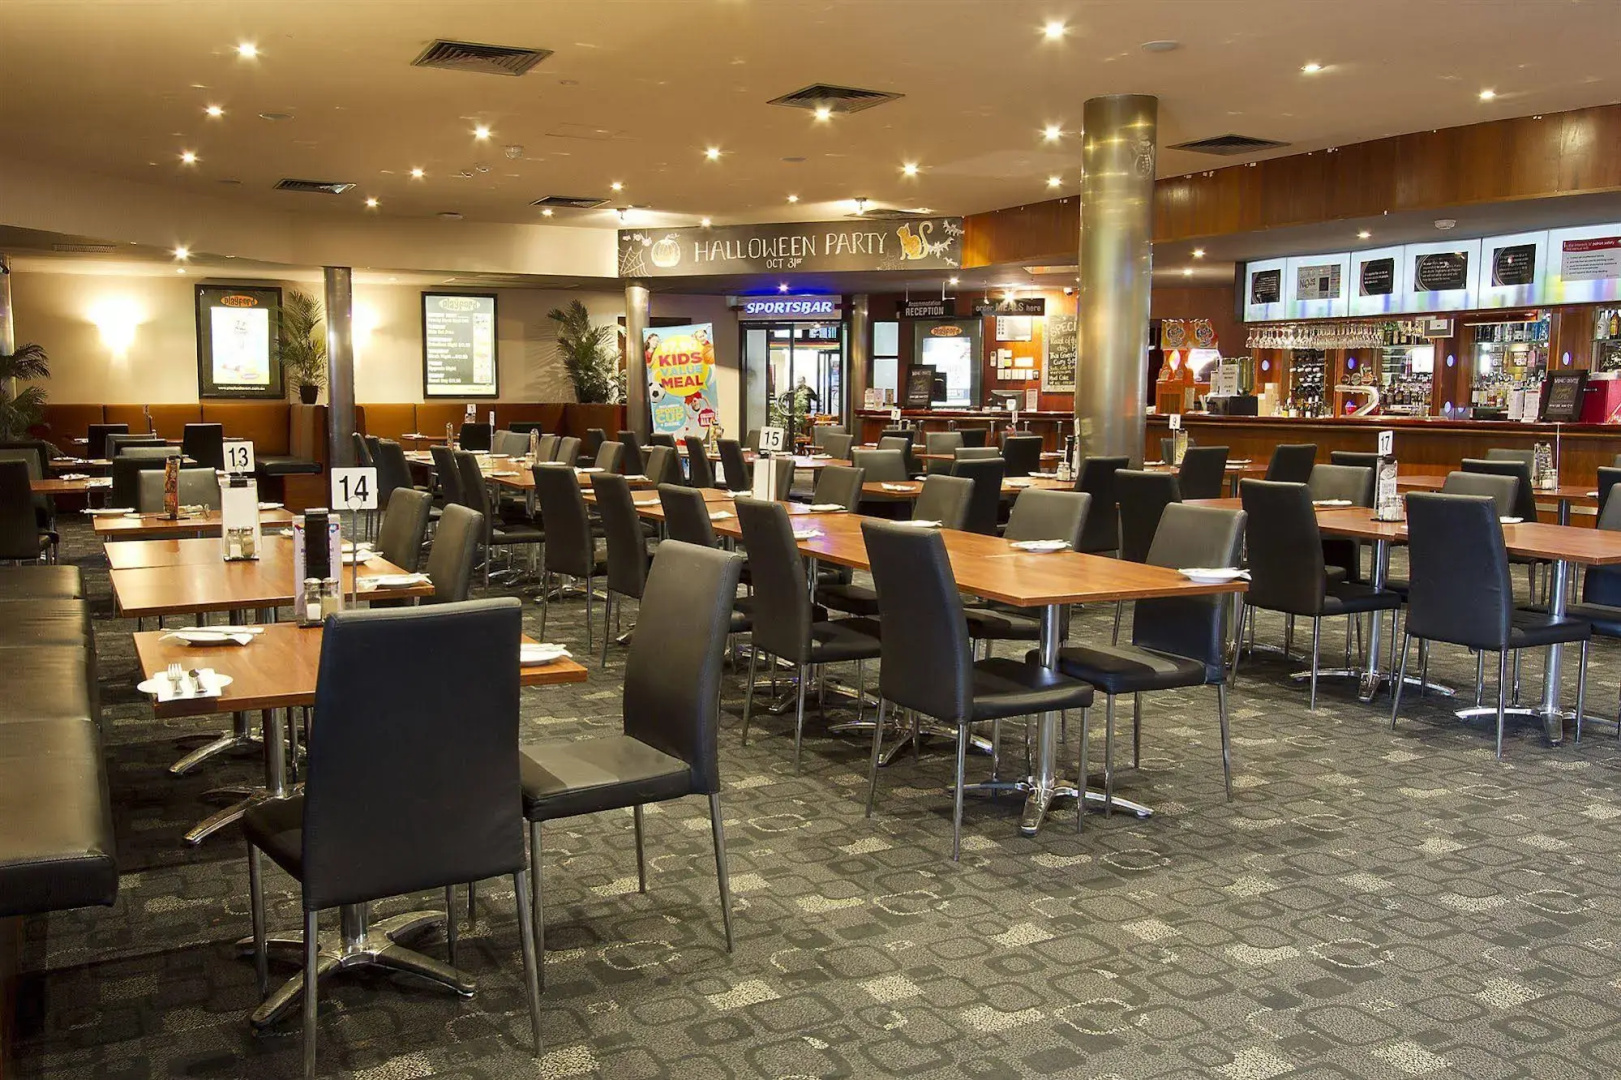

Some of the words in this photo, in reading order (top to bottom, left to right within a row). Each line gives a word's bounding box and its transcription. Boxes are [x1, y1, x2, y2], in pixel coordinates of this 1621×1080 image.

[694, 235, 816, 262] HALLOWEEN
[825, 232, 888, 255] PARTY
[766, 258, 784, 269] OCT
[746, 301, 833, 315] SPORTSBAR
[905, 306, 944, 316] RECEPTION
[995, 302, 1024, 311] MEALS
[658, 352, 703, 367] KIDS
[660, 364, 703, 377] VALUE
[661, 375, 704, 389] MEAL
[655, 411, 684, 425] CUP
[764, 431, 779, 446] 15
[1380, 435, 1390, 451] 17
[228, 447, 248, 467] 13
[338, 475, 369, 502] 14
